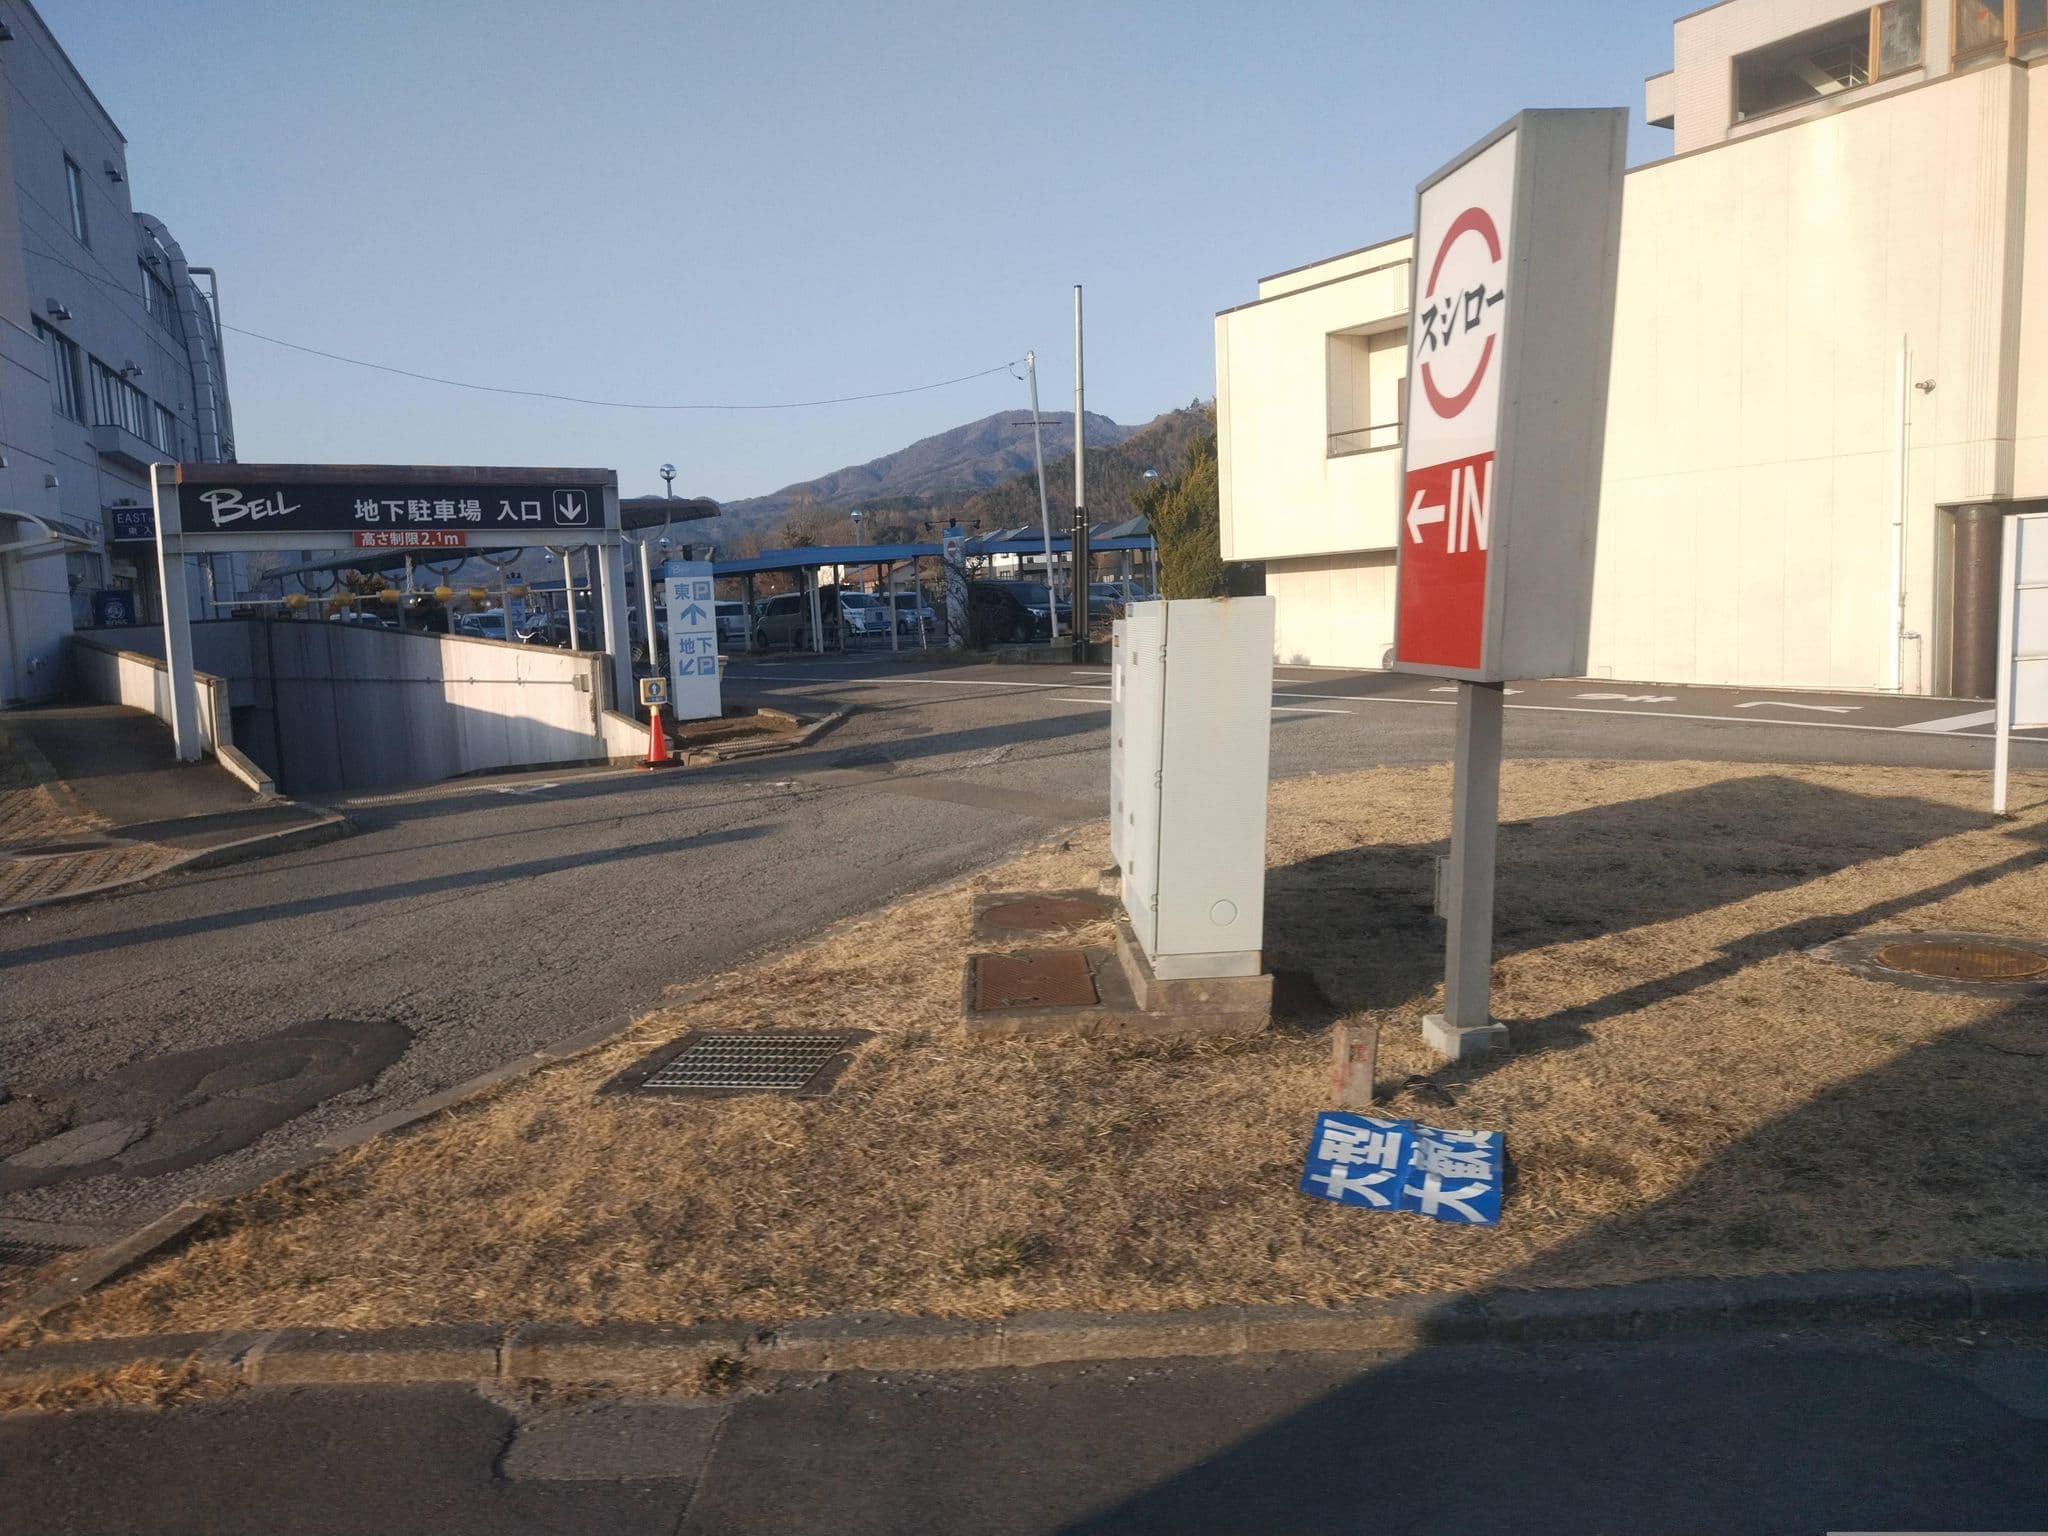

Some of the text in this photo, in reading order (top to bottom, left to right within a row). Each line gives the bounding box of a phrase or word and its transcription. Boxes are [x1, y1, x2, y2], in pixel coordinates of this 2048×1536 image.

[1416, 283, 1505, 358] スシロー
[354, 499, 542, 522] 地下駐車場 入口
[1446, 460, 1494, 554] IN
[117, 512, 147, 523] EAST
[361, 532, 459, 546] 高さ制限2.1m
[674, 583, 691, 600] 東
[680, 637, 713, 654] 地下
